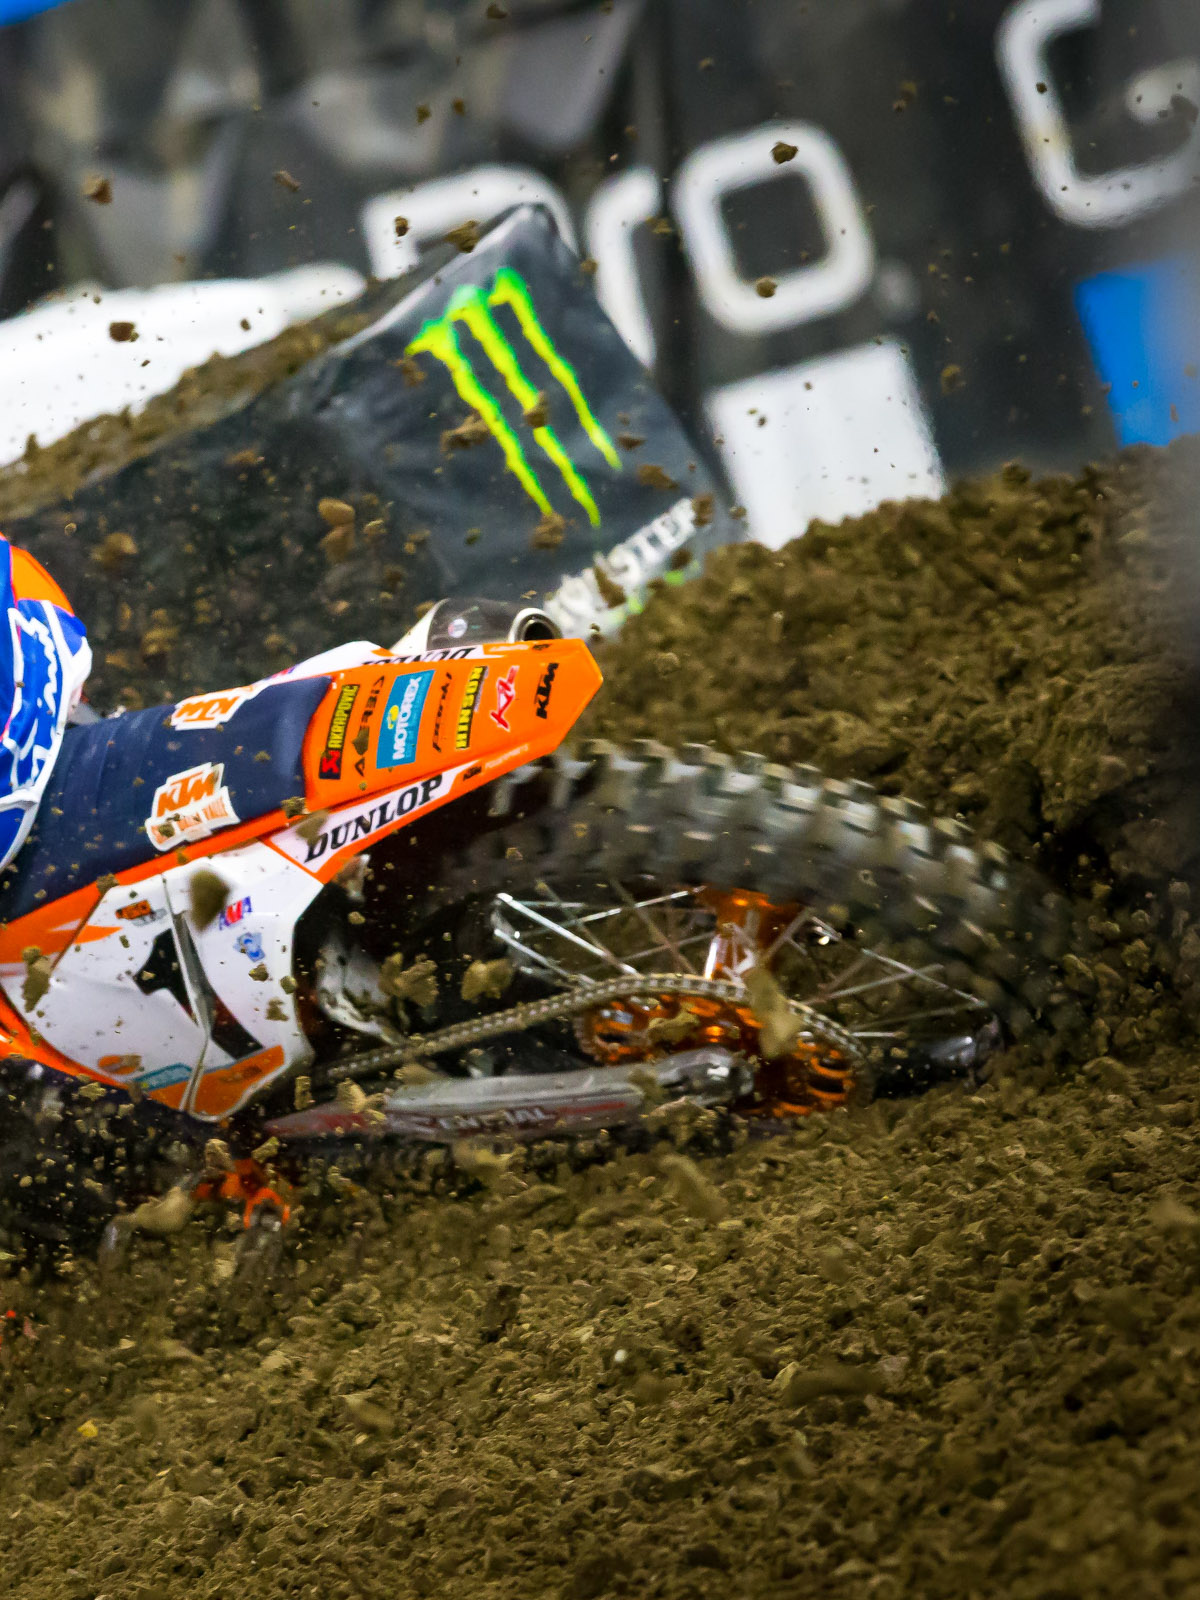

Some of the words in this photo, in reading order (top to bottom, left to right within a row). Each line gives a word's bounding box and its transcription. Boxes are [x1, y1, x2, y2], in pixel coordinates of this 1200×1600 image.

[175, 695, 241, 723] KTM
[392, 676, 422, 760] MOTOREX
[455, 666, 487, 749] HINSON
[535, 662, 560, 719] KTM
[156, 771, 218, 818] KTM
[304, 774, 443, 863] DUNLOP
